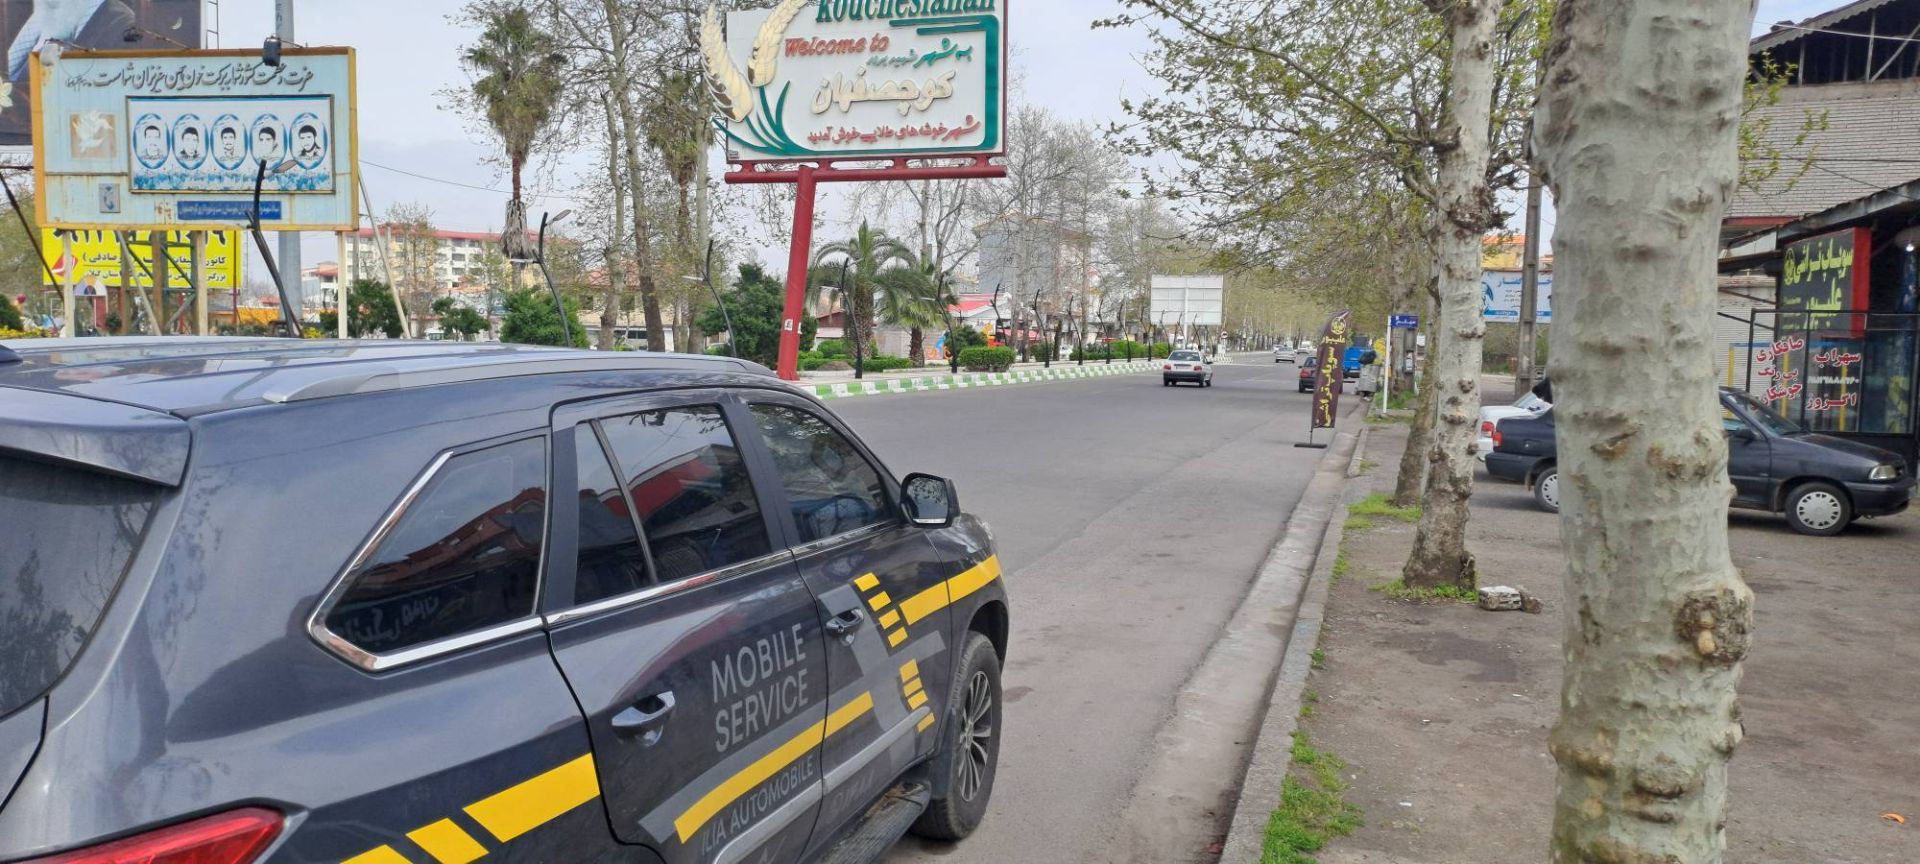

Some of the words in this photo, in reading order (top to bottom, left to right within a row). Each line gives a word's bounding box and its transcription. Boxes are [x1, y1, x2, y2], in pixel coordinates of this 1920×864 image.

[784, 36, 867, 57] Welcome
[869, 32, 890, 53] to
[913, 37, 958, 69] شهر
[283, 65, 313, 92] عزت
[810, 66, 957, 117] کوچصفهان
[807, 126, 833, 145] آمدید
[832, 126, 861, 145] خوش
[895, 124, 919, 140] های
[941, 114, 981, 142] شهر
[1756, 336, 1804, 364] صافکاری
[1814, 348, 1861, 368] سهراب
[1783, 368, 1799, 382] بی
[1807, 392, 1857, 411] اگزوز
[711, 623, 806, 703] MOBILE
[715, 669, 808, 753] SERVICE
[701, 820, 726, 855] ILIA
[730, 754, 814, 834] AUTOMOBILE
